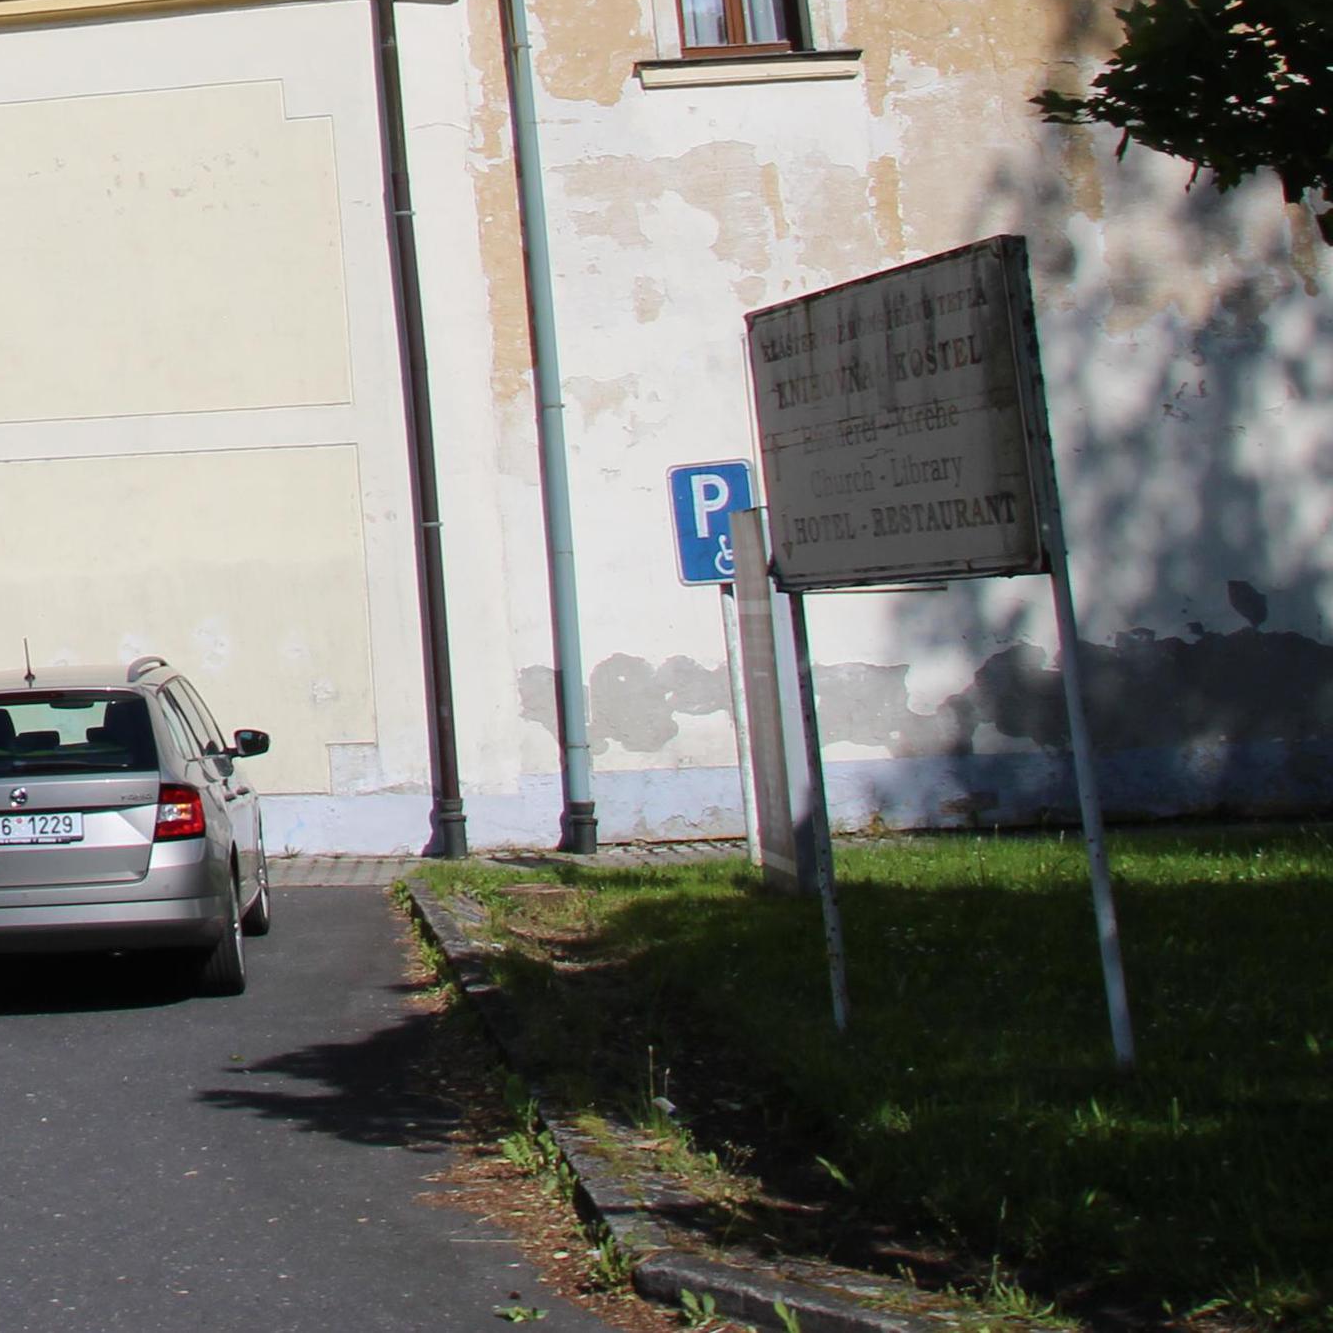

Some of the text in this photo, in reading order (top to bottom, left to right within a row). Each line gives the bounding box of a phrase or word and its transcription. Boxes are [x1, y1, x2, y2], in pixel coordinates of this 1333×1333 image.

[893, 333, 983, 381] KOSTEL
[809, 450, 963, 498] Church Library
[690, 473, 729, 539] P
[793, 493, 1016, 544] HOTEL RESTAURANT
[28, 815, 73, 836] 1229
